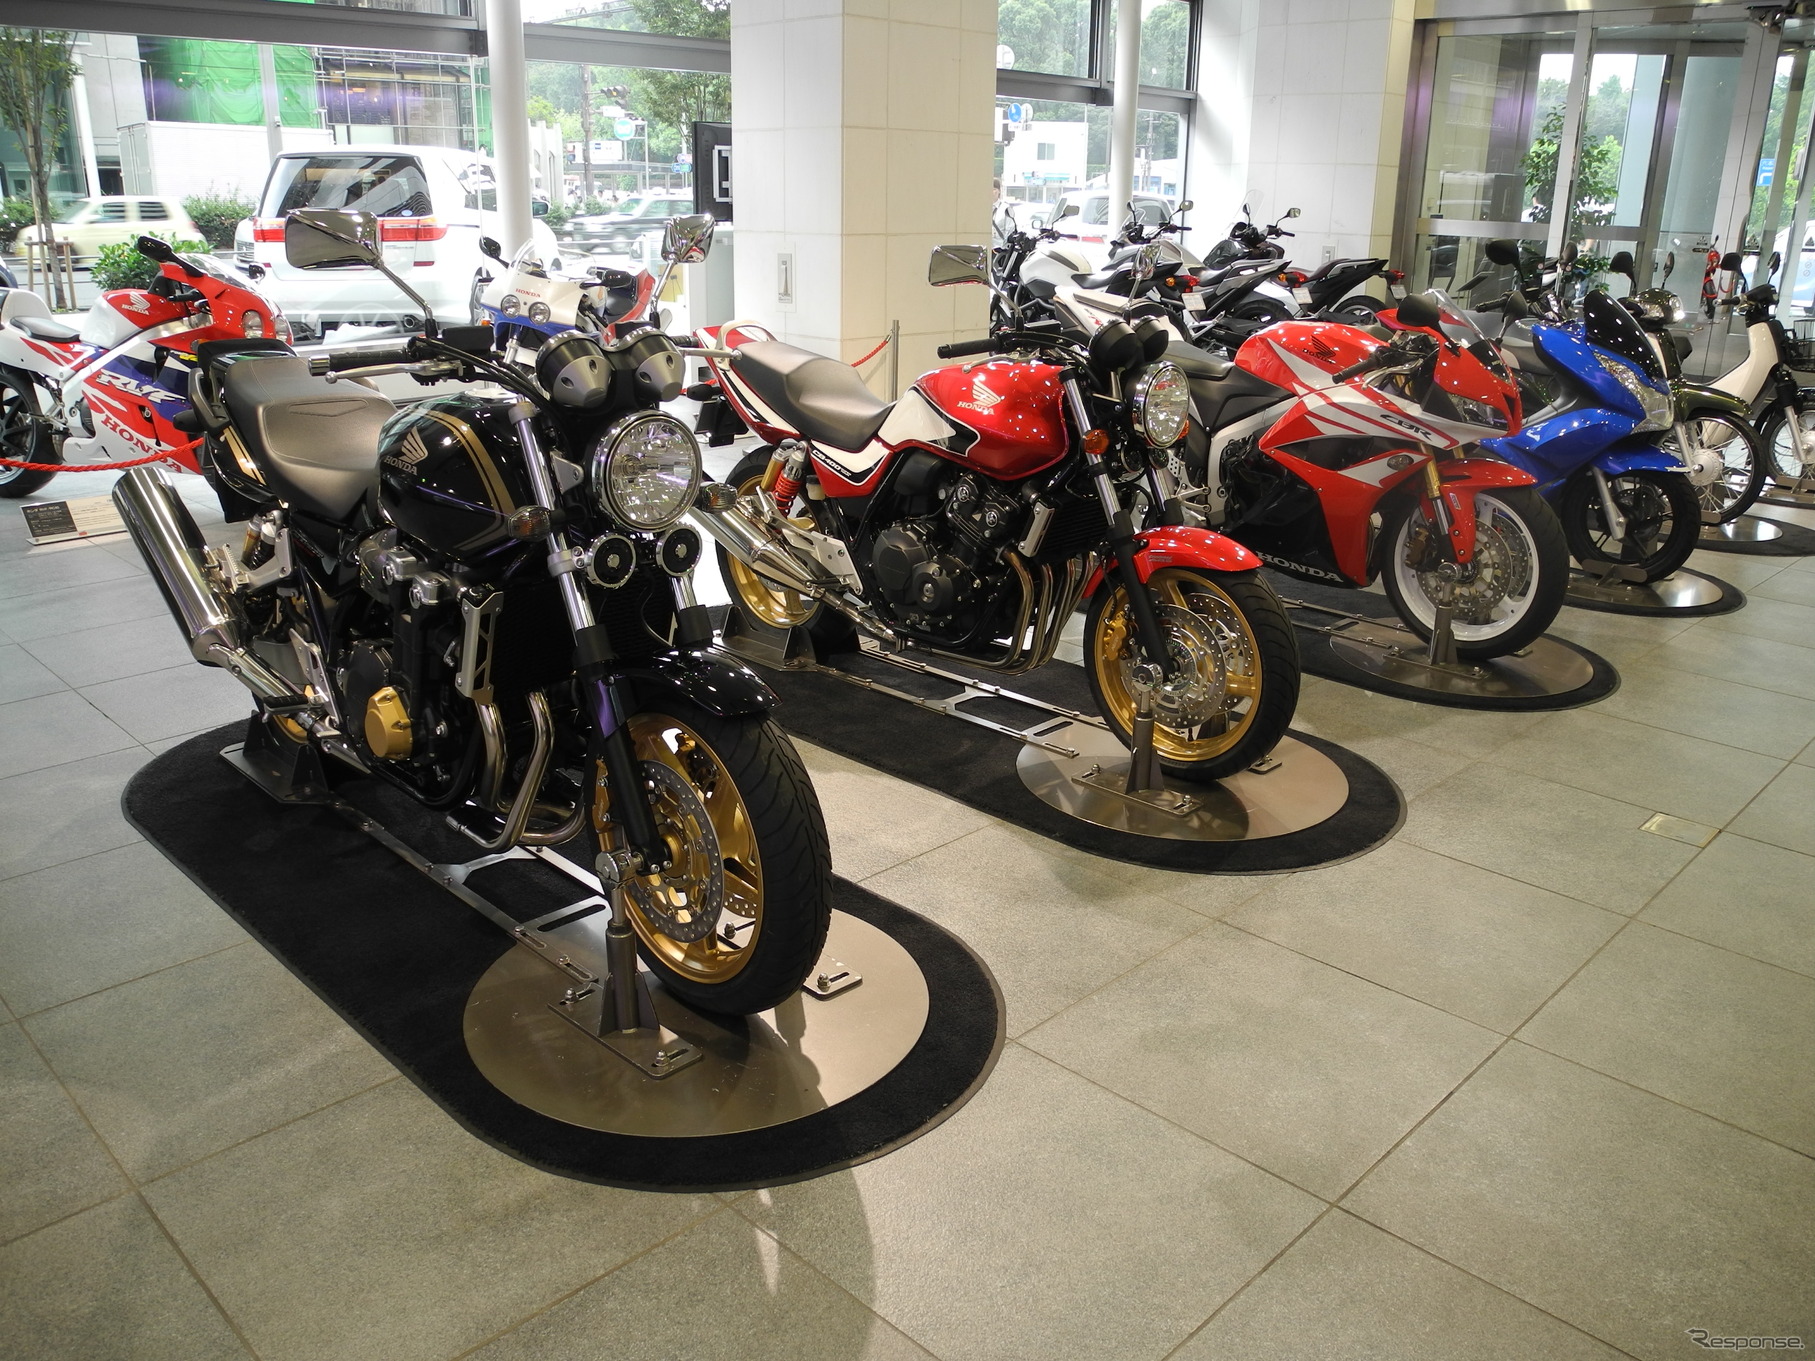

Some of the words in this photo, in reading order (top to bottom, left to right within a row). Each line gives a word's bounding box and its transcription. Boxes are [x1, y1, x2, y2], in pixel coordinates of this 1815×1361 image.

[515, 288, 541, 298] HONDA
[121, 303, 150, 316] HONDA
[957, 400, 995, 416] HONDA
[1379, 414, 1433, 442] CBR
[383, 455, 418, 476] HONDA
[1255, 550, 1344, 583] HONDA
